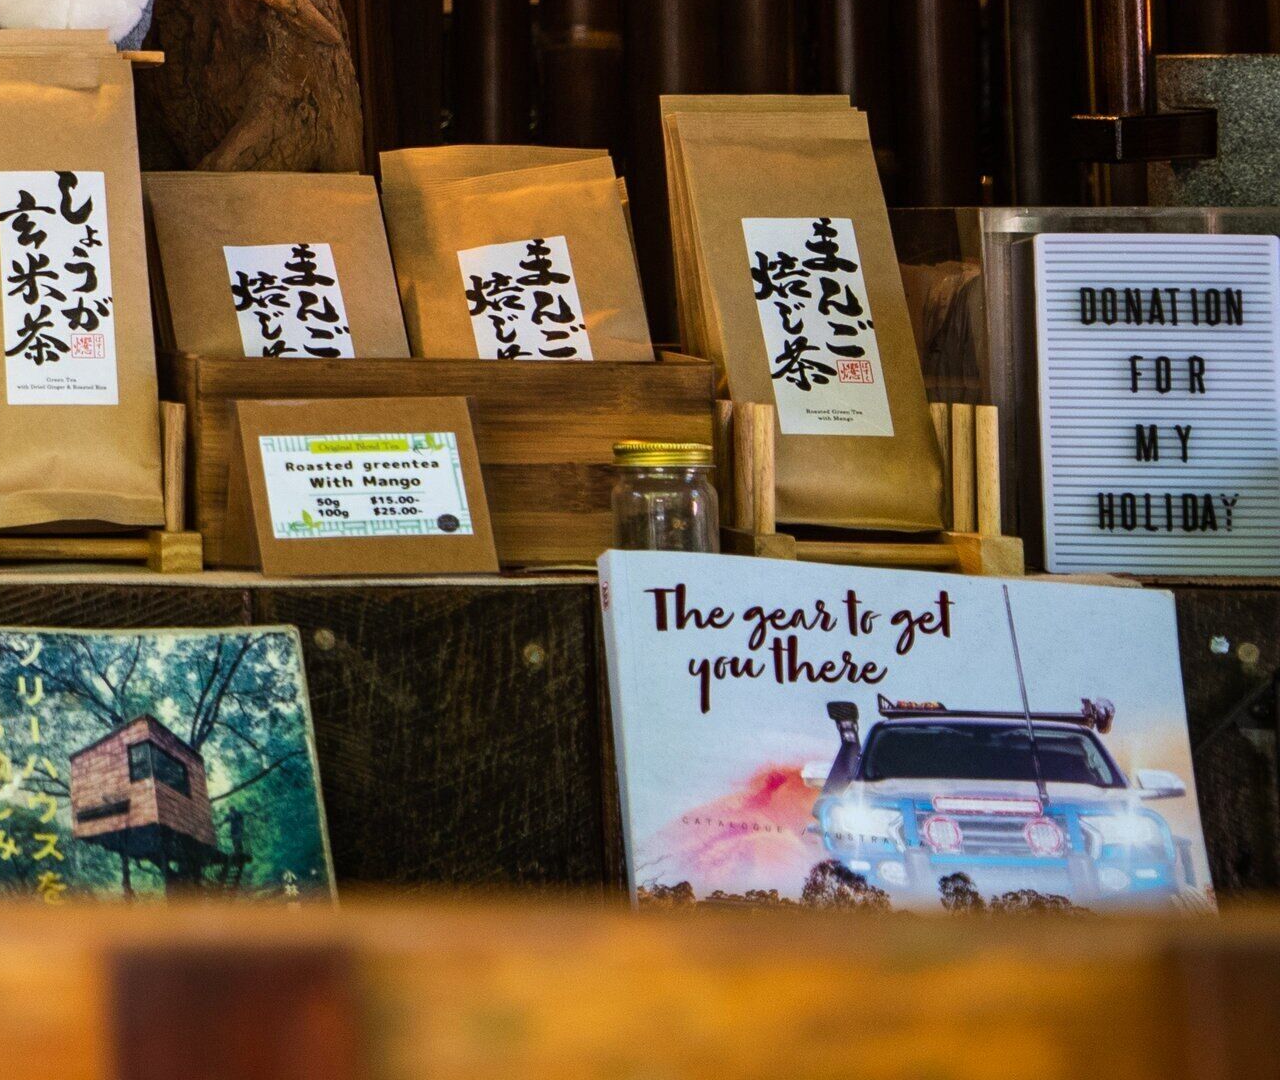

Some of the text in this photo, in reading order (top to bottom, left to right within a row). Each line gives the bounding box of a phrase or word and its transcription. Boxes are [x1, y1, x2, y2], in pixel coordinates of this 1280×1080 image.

[55, 171, 113, 331] しょうが
[750, 251, 838, 392] 焙じ茶
[1079, 287, 1243, 327] DONATION
[1129, 355, 1206, 394] FOR
[1135, 423, 1192, 463] MY
[285, 460, 439, 471] Roasted greentea
[309, 476, 421, 489] With Mango
[317, 498, 340, 507] 50g
[318, 509, 349, 518] 100g
[1097, 492, 1239, 532] HOLIDAY
[644, 583, 736, 633] The
[740, 599, 839, 651] gear
[840, 590, 882, 636] to
[889, 590, 956, 654] get
[688, 637, 889, 714] you there
[681, 816, 784, 833] CATALOGUE
